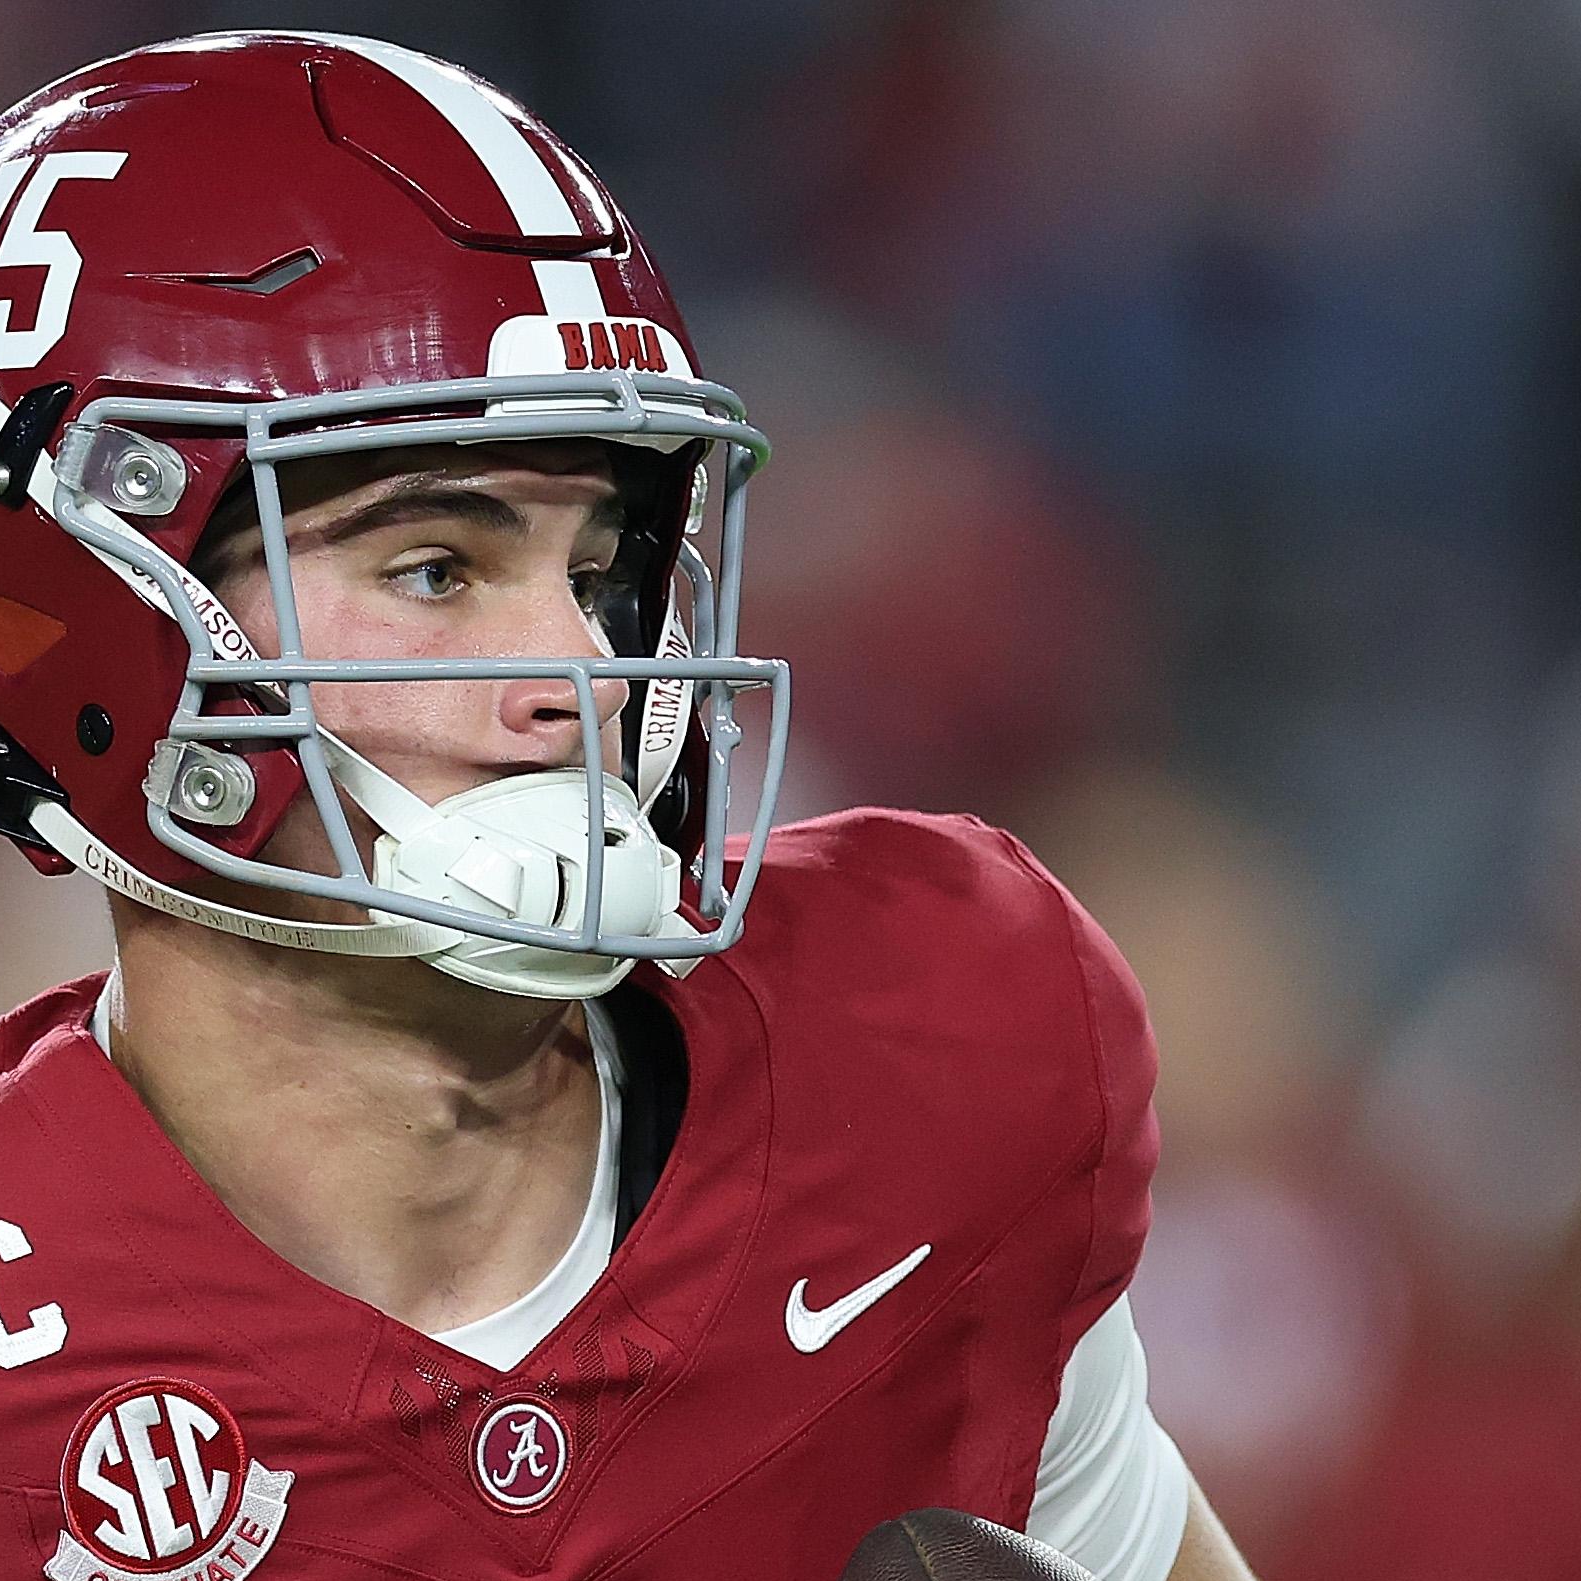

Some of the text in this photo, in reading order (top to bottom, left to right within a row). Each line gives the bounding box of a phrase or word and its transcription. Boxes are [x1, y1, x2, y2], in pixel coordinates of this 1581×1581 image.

[556, 322, 669, 373] BAMA
[76, 1393, 232, 1562] SEC
[492, 1415, 549, 1488] A
